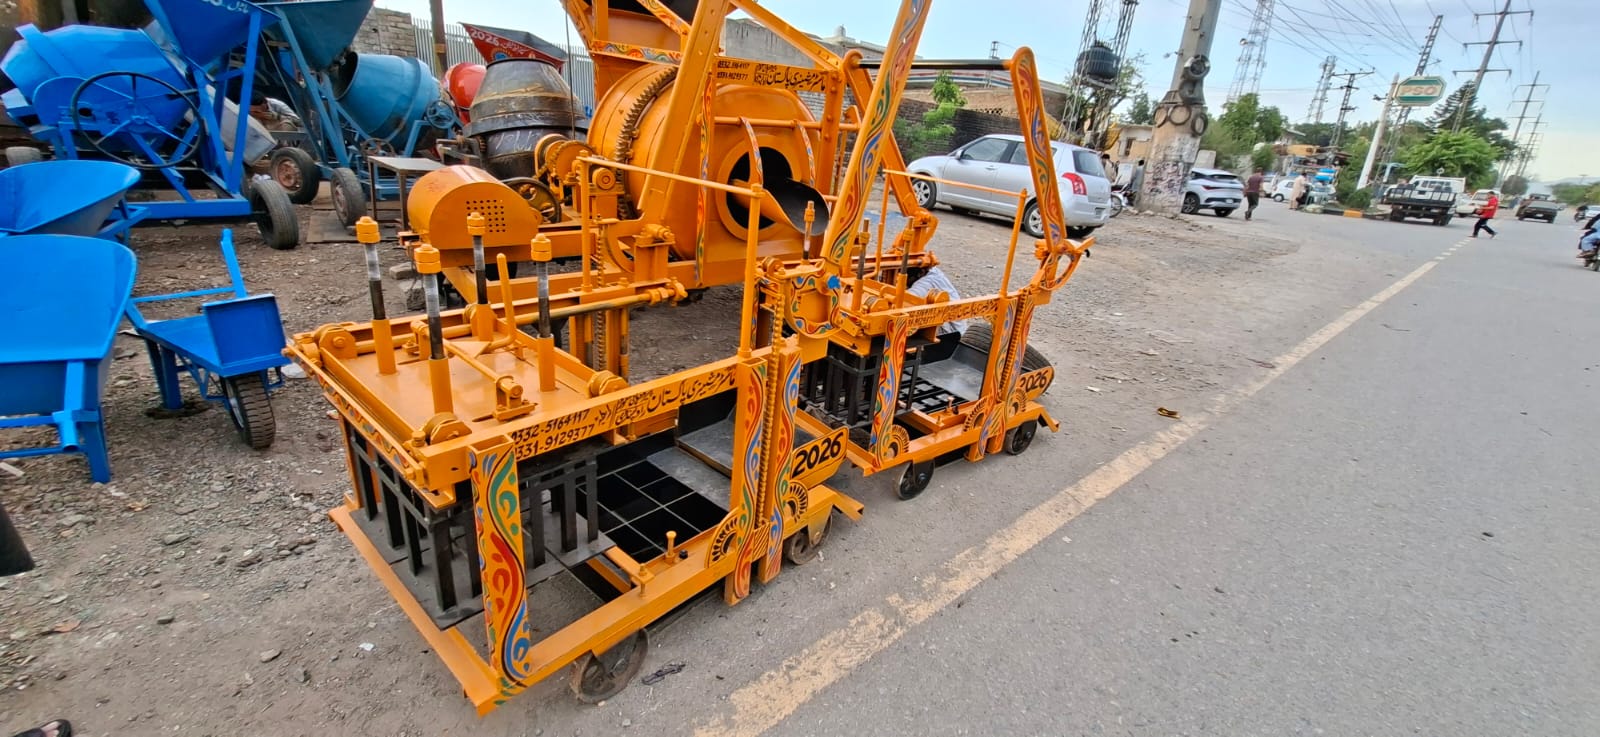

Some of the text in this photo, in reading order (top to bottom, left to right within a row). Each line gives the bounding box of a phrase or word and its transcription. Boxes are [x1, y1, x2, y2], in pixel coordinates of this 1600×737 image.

[1401, 86, 1436, 95] PSO
[1020, 370, 1049, 393] 2026
[791, 431, 844, 479] 2026
